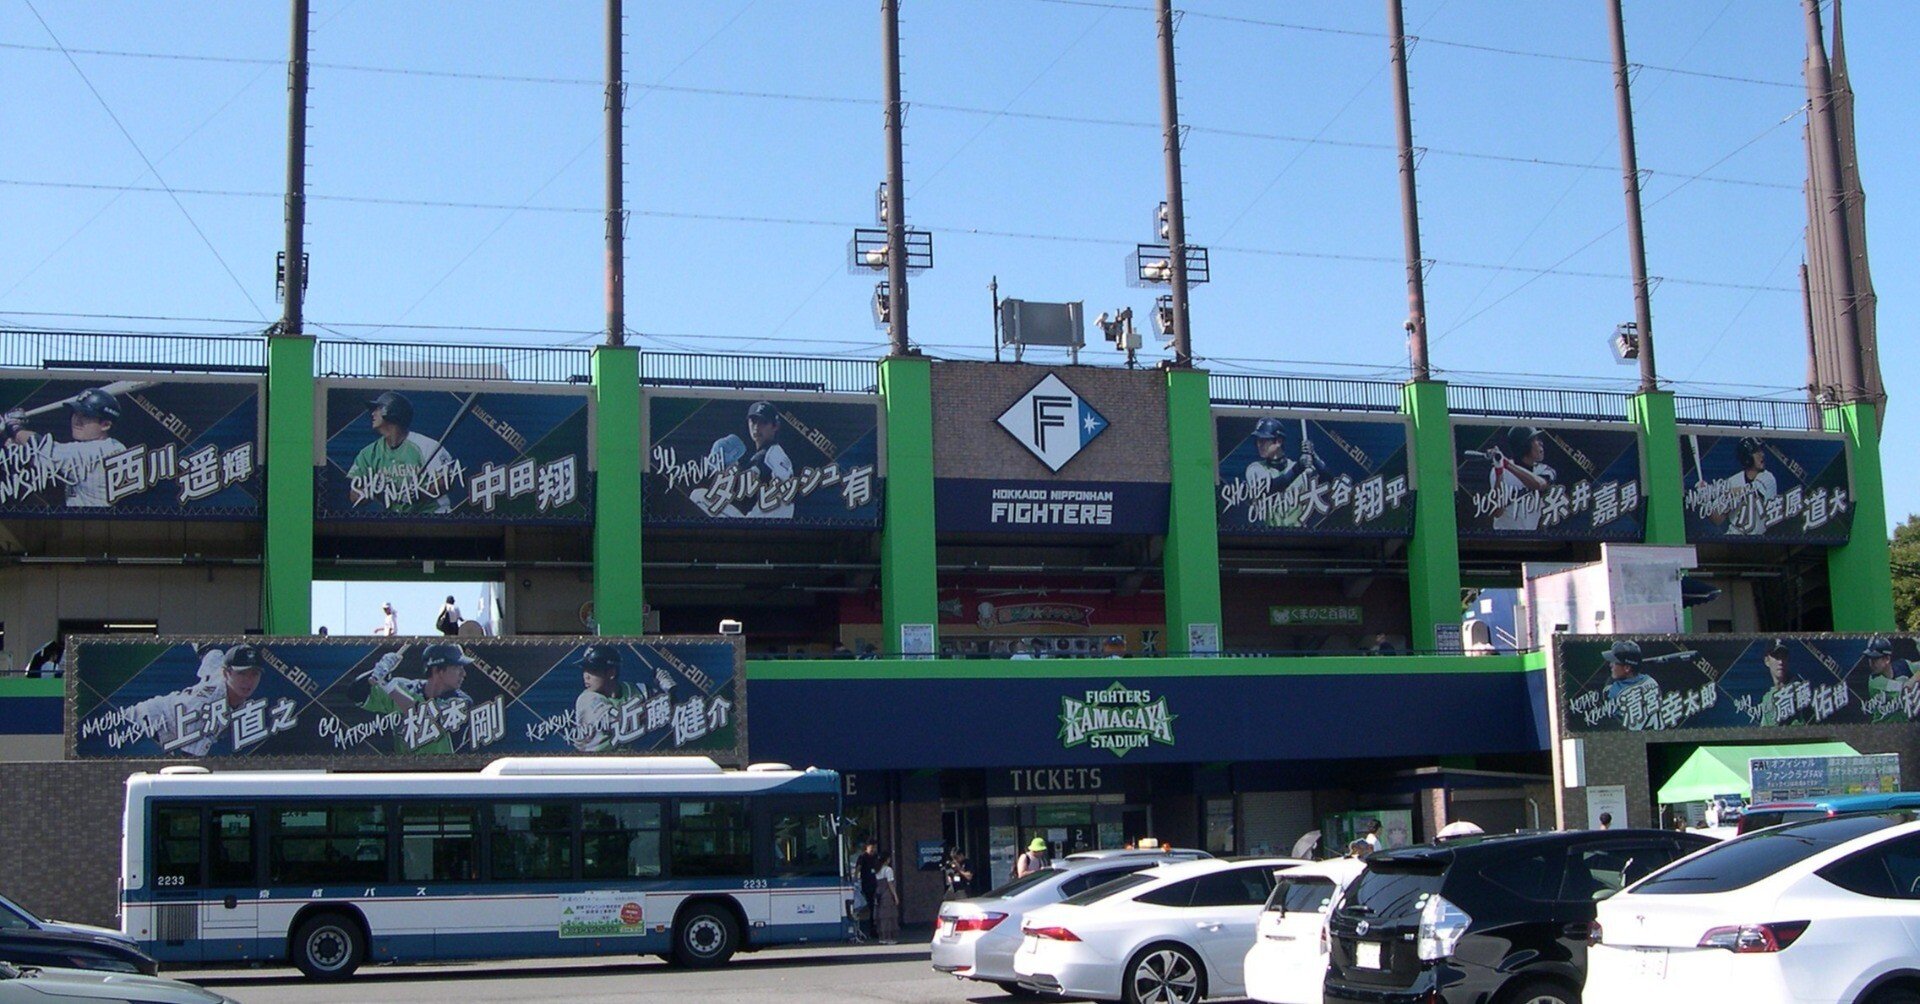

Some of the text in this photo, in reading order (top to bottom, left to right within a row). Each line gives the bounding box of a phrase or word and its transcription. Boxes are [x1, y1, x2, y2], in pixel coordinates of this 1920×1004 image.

[137, 395, 194, 441] SINCE 2011
[105, 444, 252, 503] 西川遥輝
[471, 456, 576, 511] 中田翔
[992, 489, 1113, 501] HOKKAIDO NIPPONHAM
[991, 502, 1113, 525] FIGHTERS
[1299, 475, 1407, 524] 大谷翔平
[1542, 481, 1638, 527] 糸井嘉男
[1735, 485, 1847, 532] 小笠原道大
[262, 648, 320, 694] SINCE 2012
[464, 648, 522, 693] SINCE 2012
[684, 664, 715, 690] 2012
[1085, 689, 1151, 703] FIGHTERS
[163, 698, 297, 750] 上沢直之
[318, 715, 340, 738] GO
[334, 711, 402, 750] MATSUMOTO
[404, 696, 505, 749] 松本剛
[610, 695, 730, 747] 近藤健介
[1063, 698, 1172, 744] KAMAGAYA
[1090, 734, 1149, 748] STADIUM
[1010, 768, 1102, 791] TICKETS
[1771, 758, 1816, 769] オフィシャル
[157, 875, 186, 886] 2233
[743, 879, 768, 889] 2233
